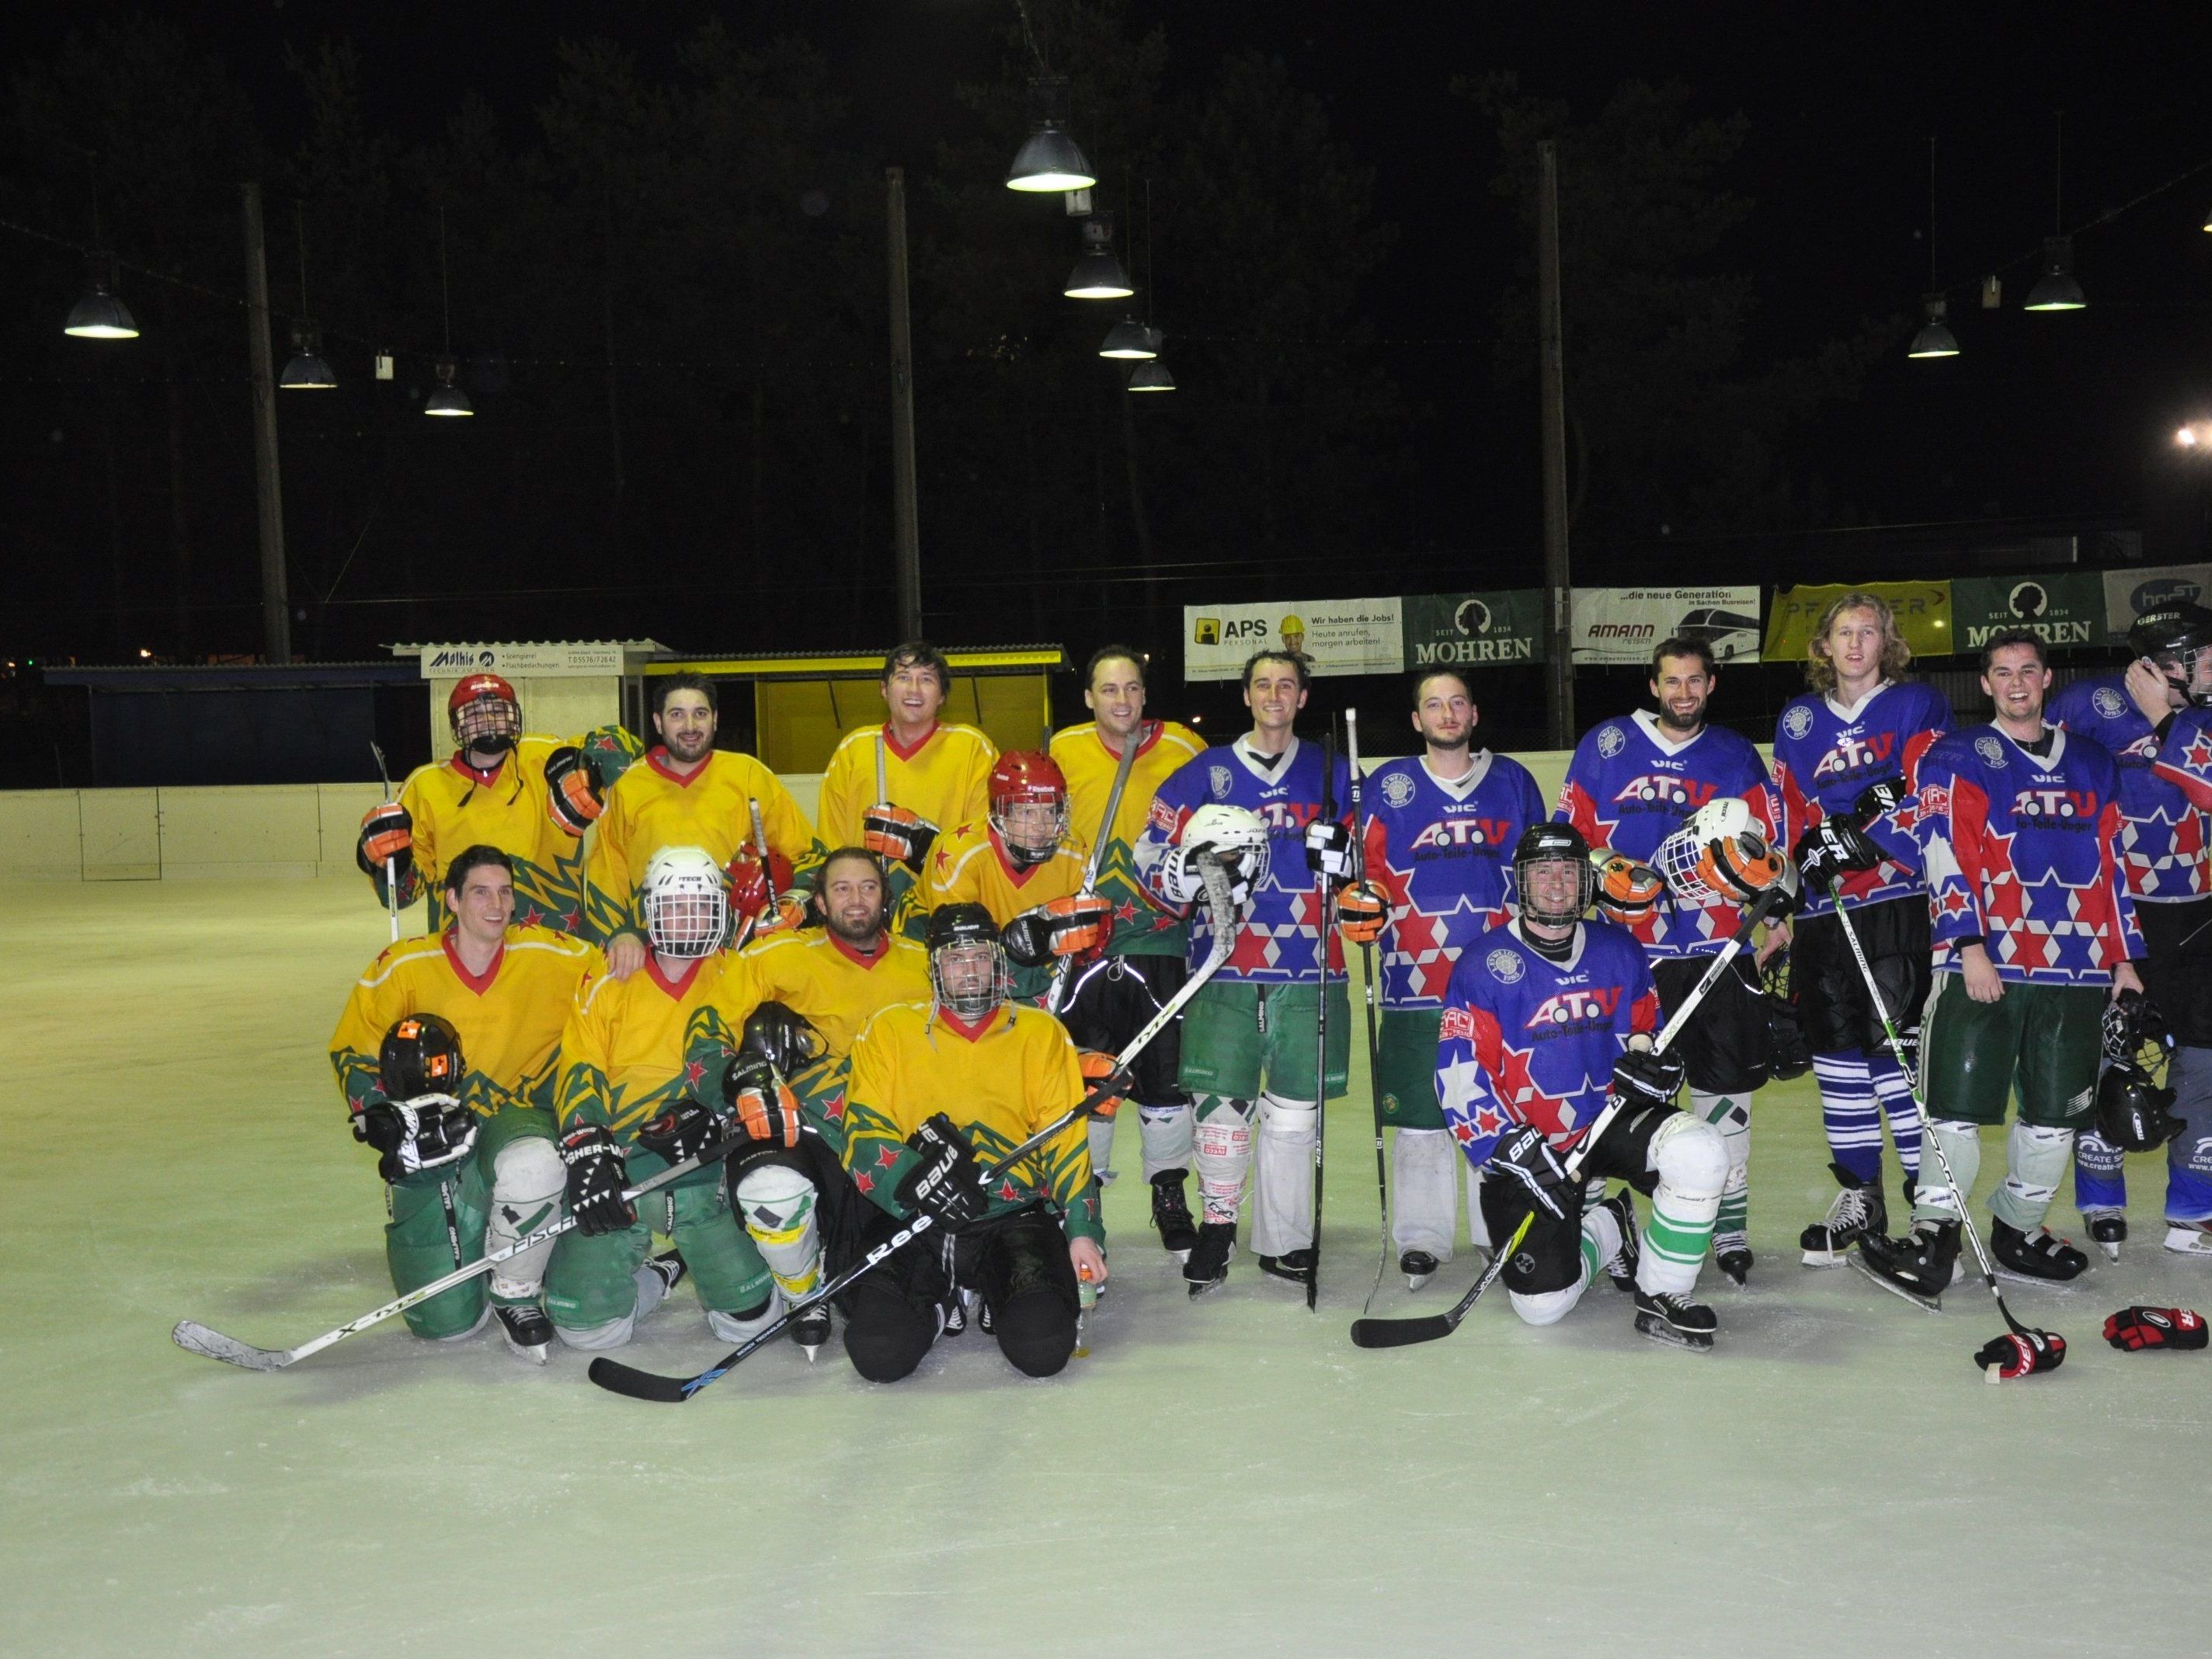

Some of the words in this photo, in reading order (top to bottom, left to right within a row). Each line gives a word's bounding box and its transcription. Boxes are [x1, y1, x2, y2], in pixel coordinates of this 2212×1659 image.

[1675, 590, 1732, 599] Generation
[1328, 615, 1354, 624] haben
[1225, 619, 1268, 638] APS
[1338, 628, 1370, 637] anrufen,
[1312, 640, 1343, 649] morgen
[1415, 637, 1532, 664] MOHREN
[1836, 725, 1865, 738] VIC
[1650, 760, 1685, 771] VIC
[2031, 774, 2065, 783] VIC
[1259, 787, 1289, 798] VIC
[1442, 804, 1477, 813] VIC
[1849, 931, 1870, 972] SALMING
[1555, 974, 1591, 986] VIC
[732, 1061, 767, 1081] SALMING
[2078, 1151, 2112, 1163] CREATE
[666, 1196, 675, 1231] SALMING
[449, 1226, 462, 1261] SALMING
